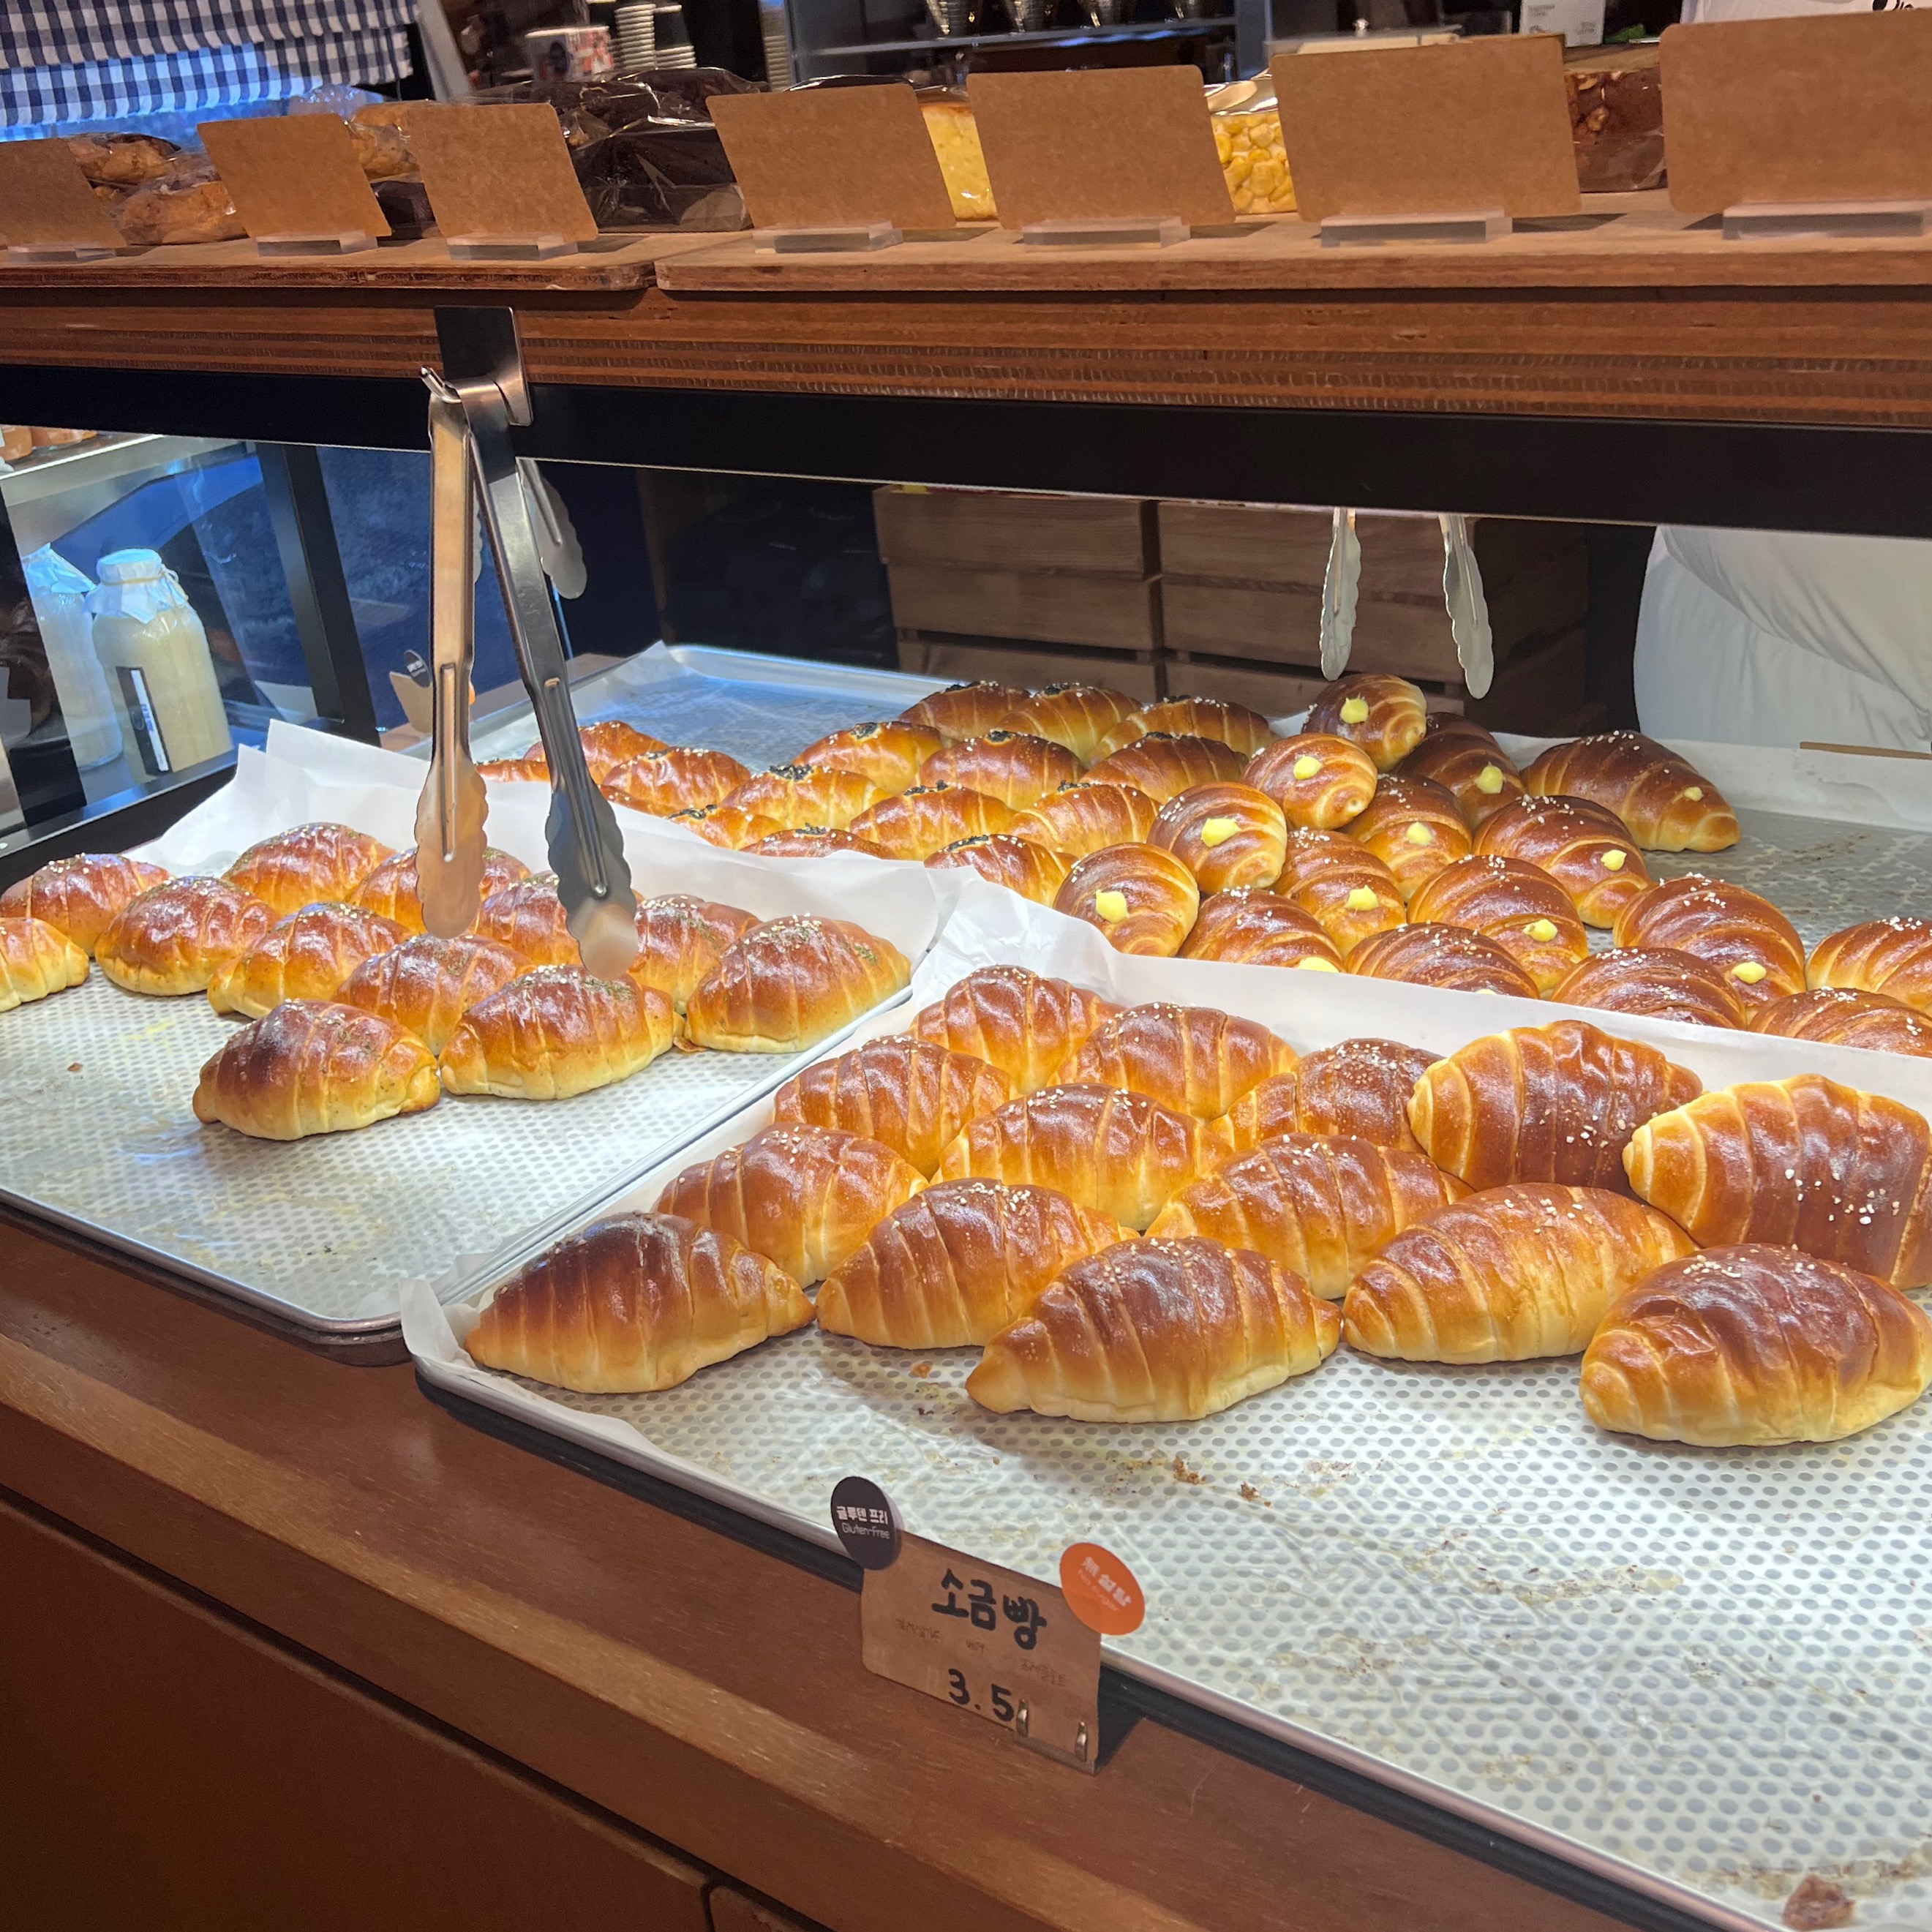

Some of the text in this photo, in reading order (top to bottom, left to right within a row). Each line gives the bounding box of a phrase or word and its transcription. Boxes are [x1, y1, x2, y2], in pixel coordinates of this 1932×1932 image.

[836, 1506, 889, 1525] 글루텐 프리
[931, 1568, 1048, 1650] 소금빵
[948, 1668, 1015, 1722] 3.5
